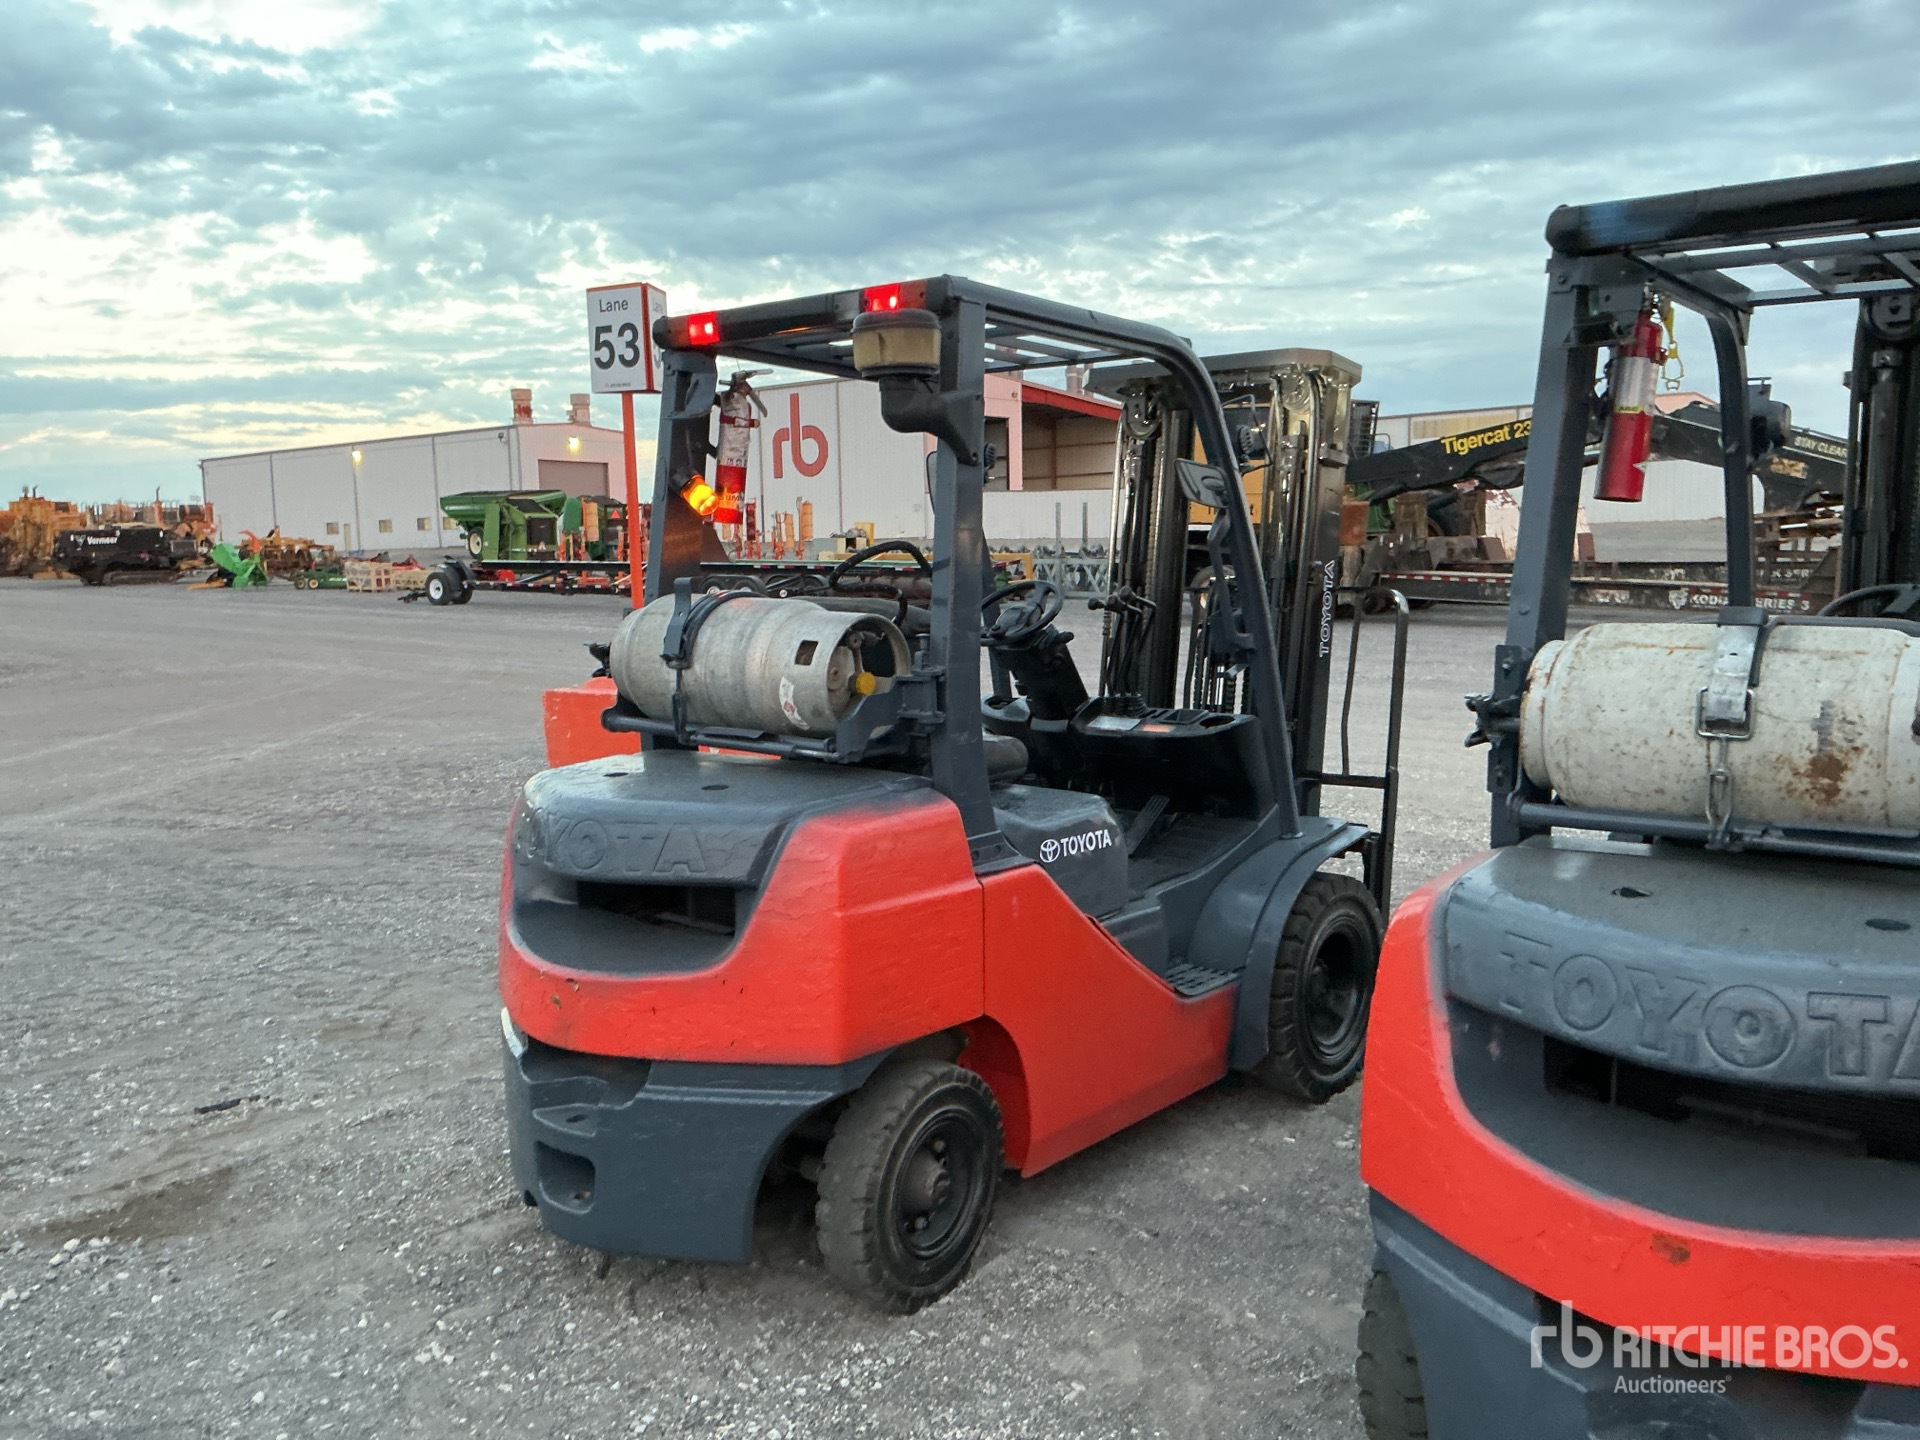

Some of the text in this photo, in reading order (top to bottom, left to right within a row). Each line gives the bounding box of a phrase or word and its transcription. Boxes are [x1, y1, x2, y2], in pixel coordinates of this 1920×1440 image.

[599, 299, 629, 313] Lane
[594, 322, 640, 370] 53
[772, 392, 829, 479] rb
[1441, 424, 1511, 455] Tigercat
[1794, 436, 1848, 458] STAY CLEAR
[1319, 560, 1335, 658] TOYOTA
[1755, 597, 1796, 609] ERIES
[1061, 829, 1112, 857] TOYOTA
